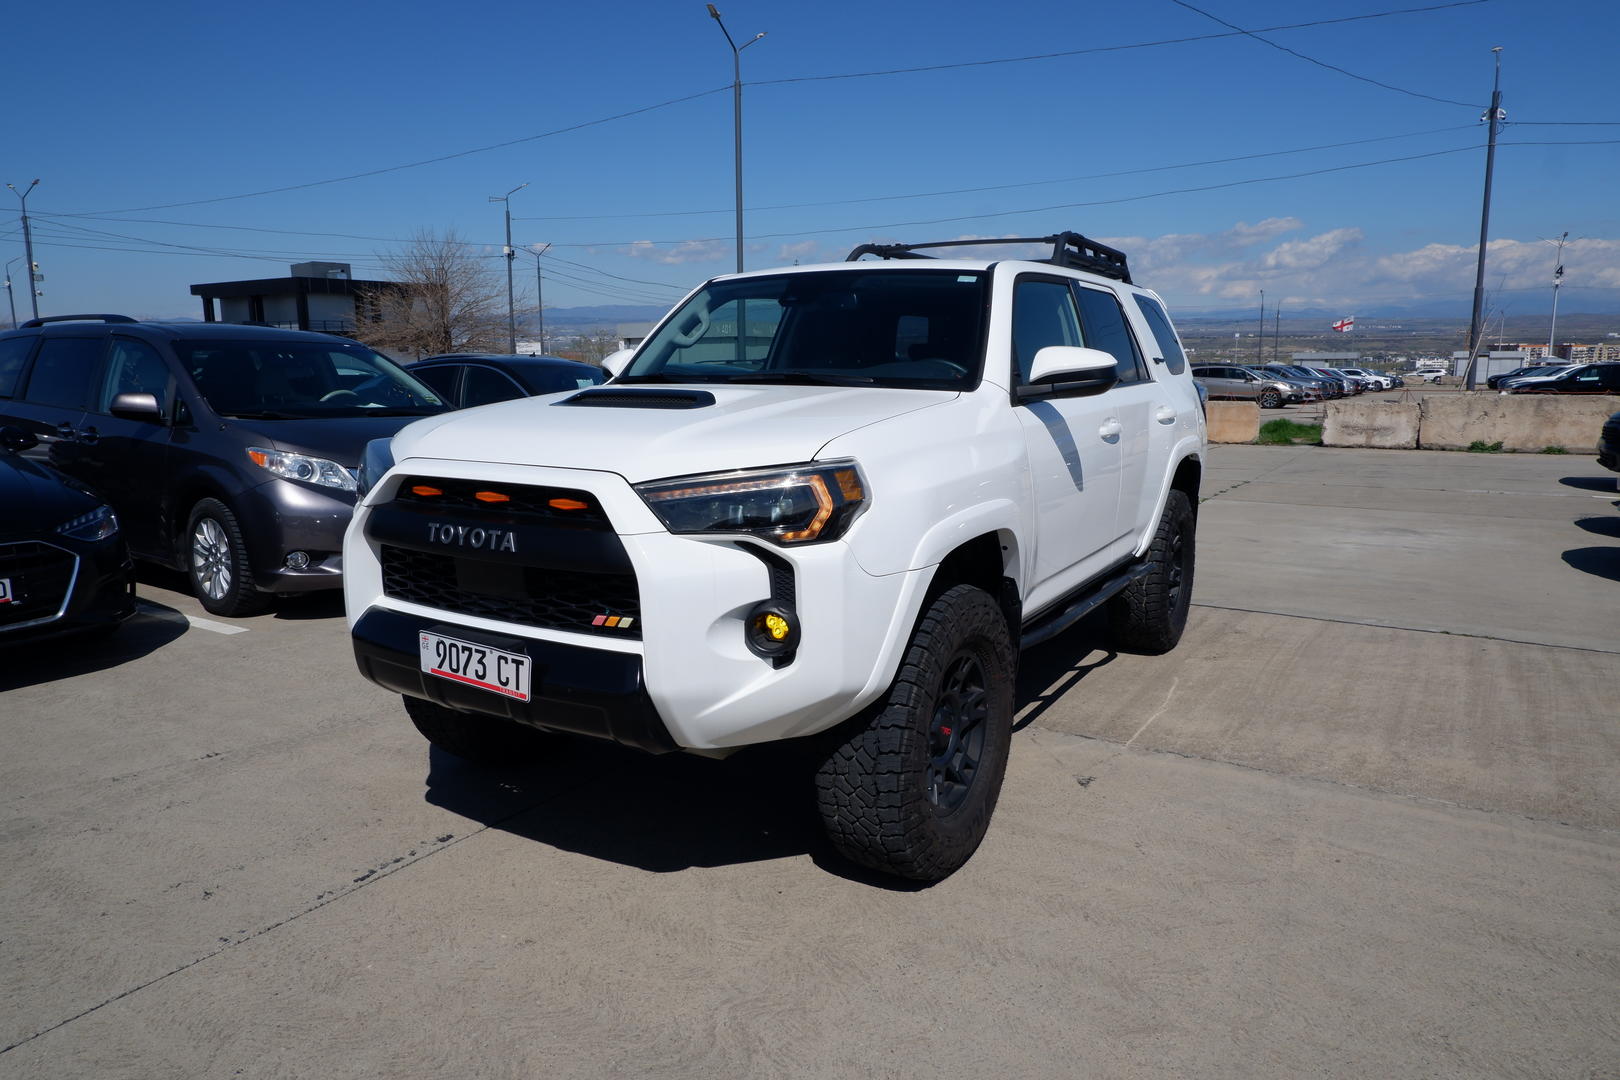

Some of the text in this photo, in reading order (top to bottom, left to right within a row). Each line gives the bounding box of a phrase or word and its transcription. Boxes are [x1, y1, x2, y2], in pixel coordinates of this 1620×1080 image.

[428, 522, 515, 553] TOYOTA
[435, 639, 525, 691] 9073 CT
